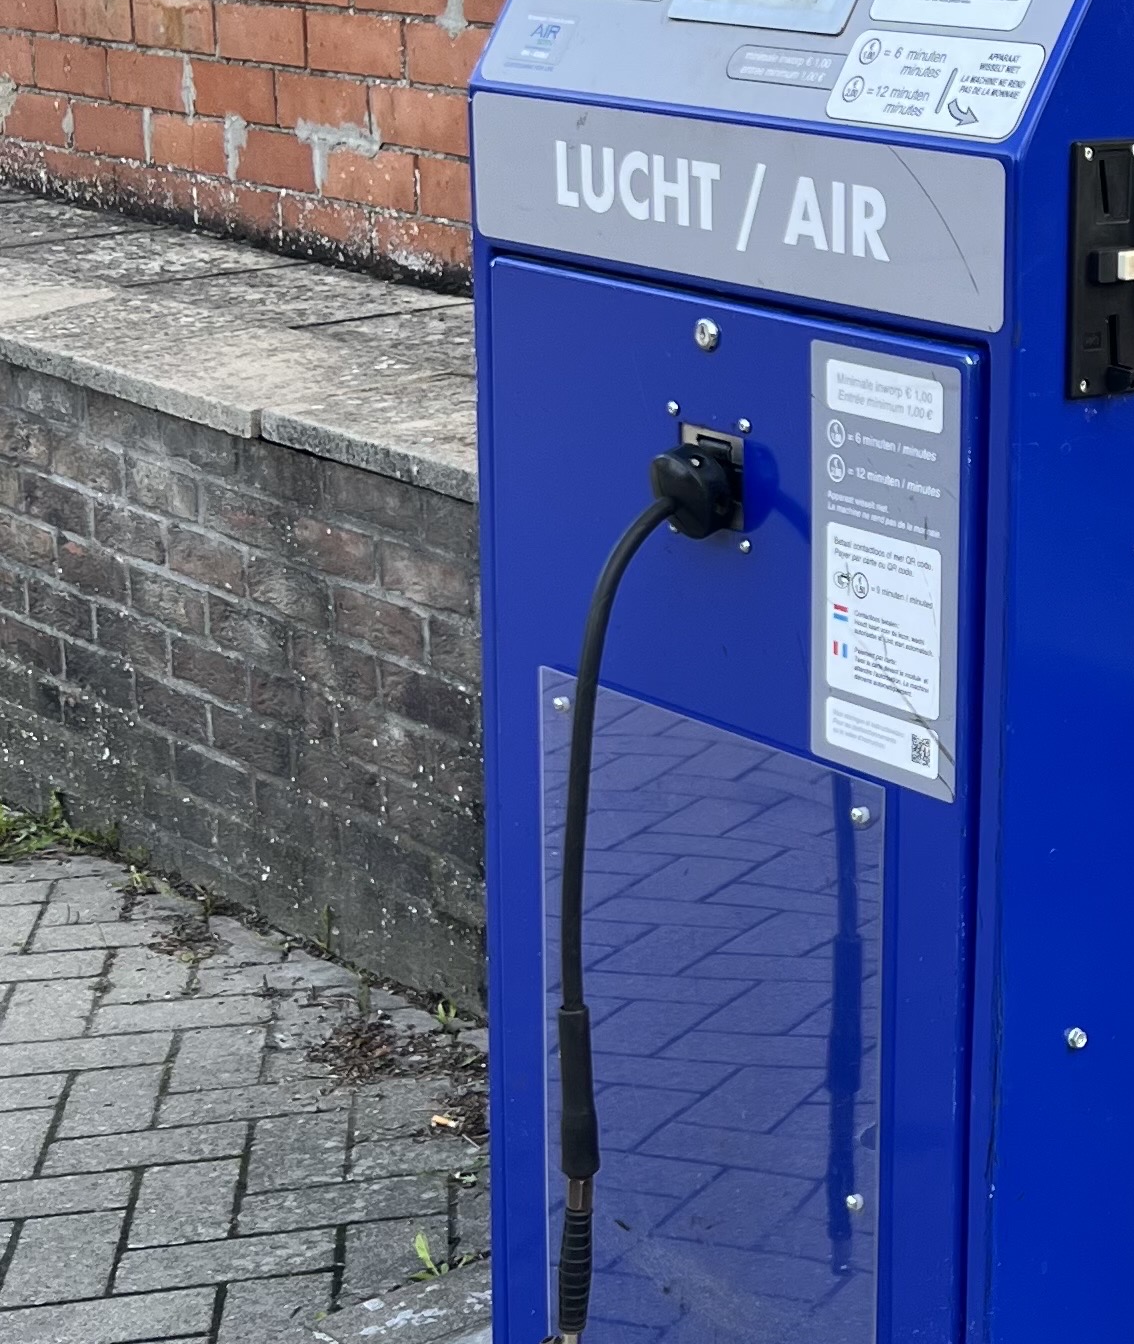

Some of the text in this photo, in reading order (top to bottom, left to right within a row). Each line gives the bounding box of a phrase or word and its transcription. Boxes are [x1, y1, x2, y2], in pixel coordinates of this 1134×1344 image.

[530, 23, 561, 40] AIR
[894, 46, 904, 59] 6
[906, 48, 948, 64] minuten
[900, 64, 942, 79] minutes
[960, 75, 970, 83] LA
[876, 85, 890, 98] 12
[890, 86, 931, 102] minuten
[959, 85, 973, 94] PAS
[882, 101, 924, 117] minutes
[555, 139, 891, 263] LUCHT / AIR
[836, 372, 874, 391] Minimale
[874, 381, 904, 398] inworp
[904, 387, 913, 400] €
[867, 397, 905, 414] minimum
[926, 408, 933, 421] €
[854, 432, 862, 445] 6
[862, 435, 896, 453] minuten
[902, 443, 937, 462] minutes
[855, 467, 866, 480] 12
[867, 470, 901, 488] minuten
[906, 479, 941, 498] minutes
[827, 501, 836, 510] La
[834, 548, 851, 560] Payer
[851, 553, 862, 563] par
[862, 556, 878, 567] carte
[886, 562, 898, 573] QR
[853, 542, 886, 558] contactloos
[905, 556, 917, 567] QR
[881, 587, 905, 601] minuten
